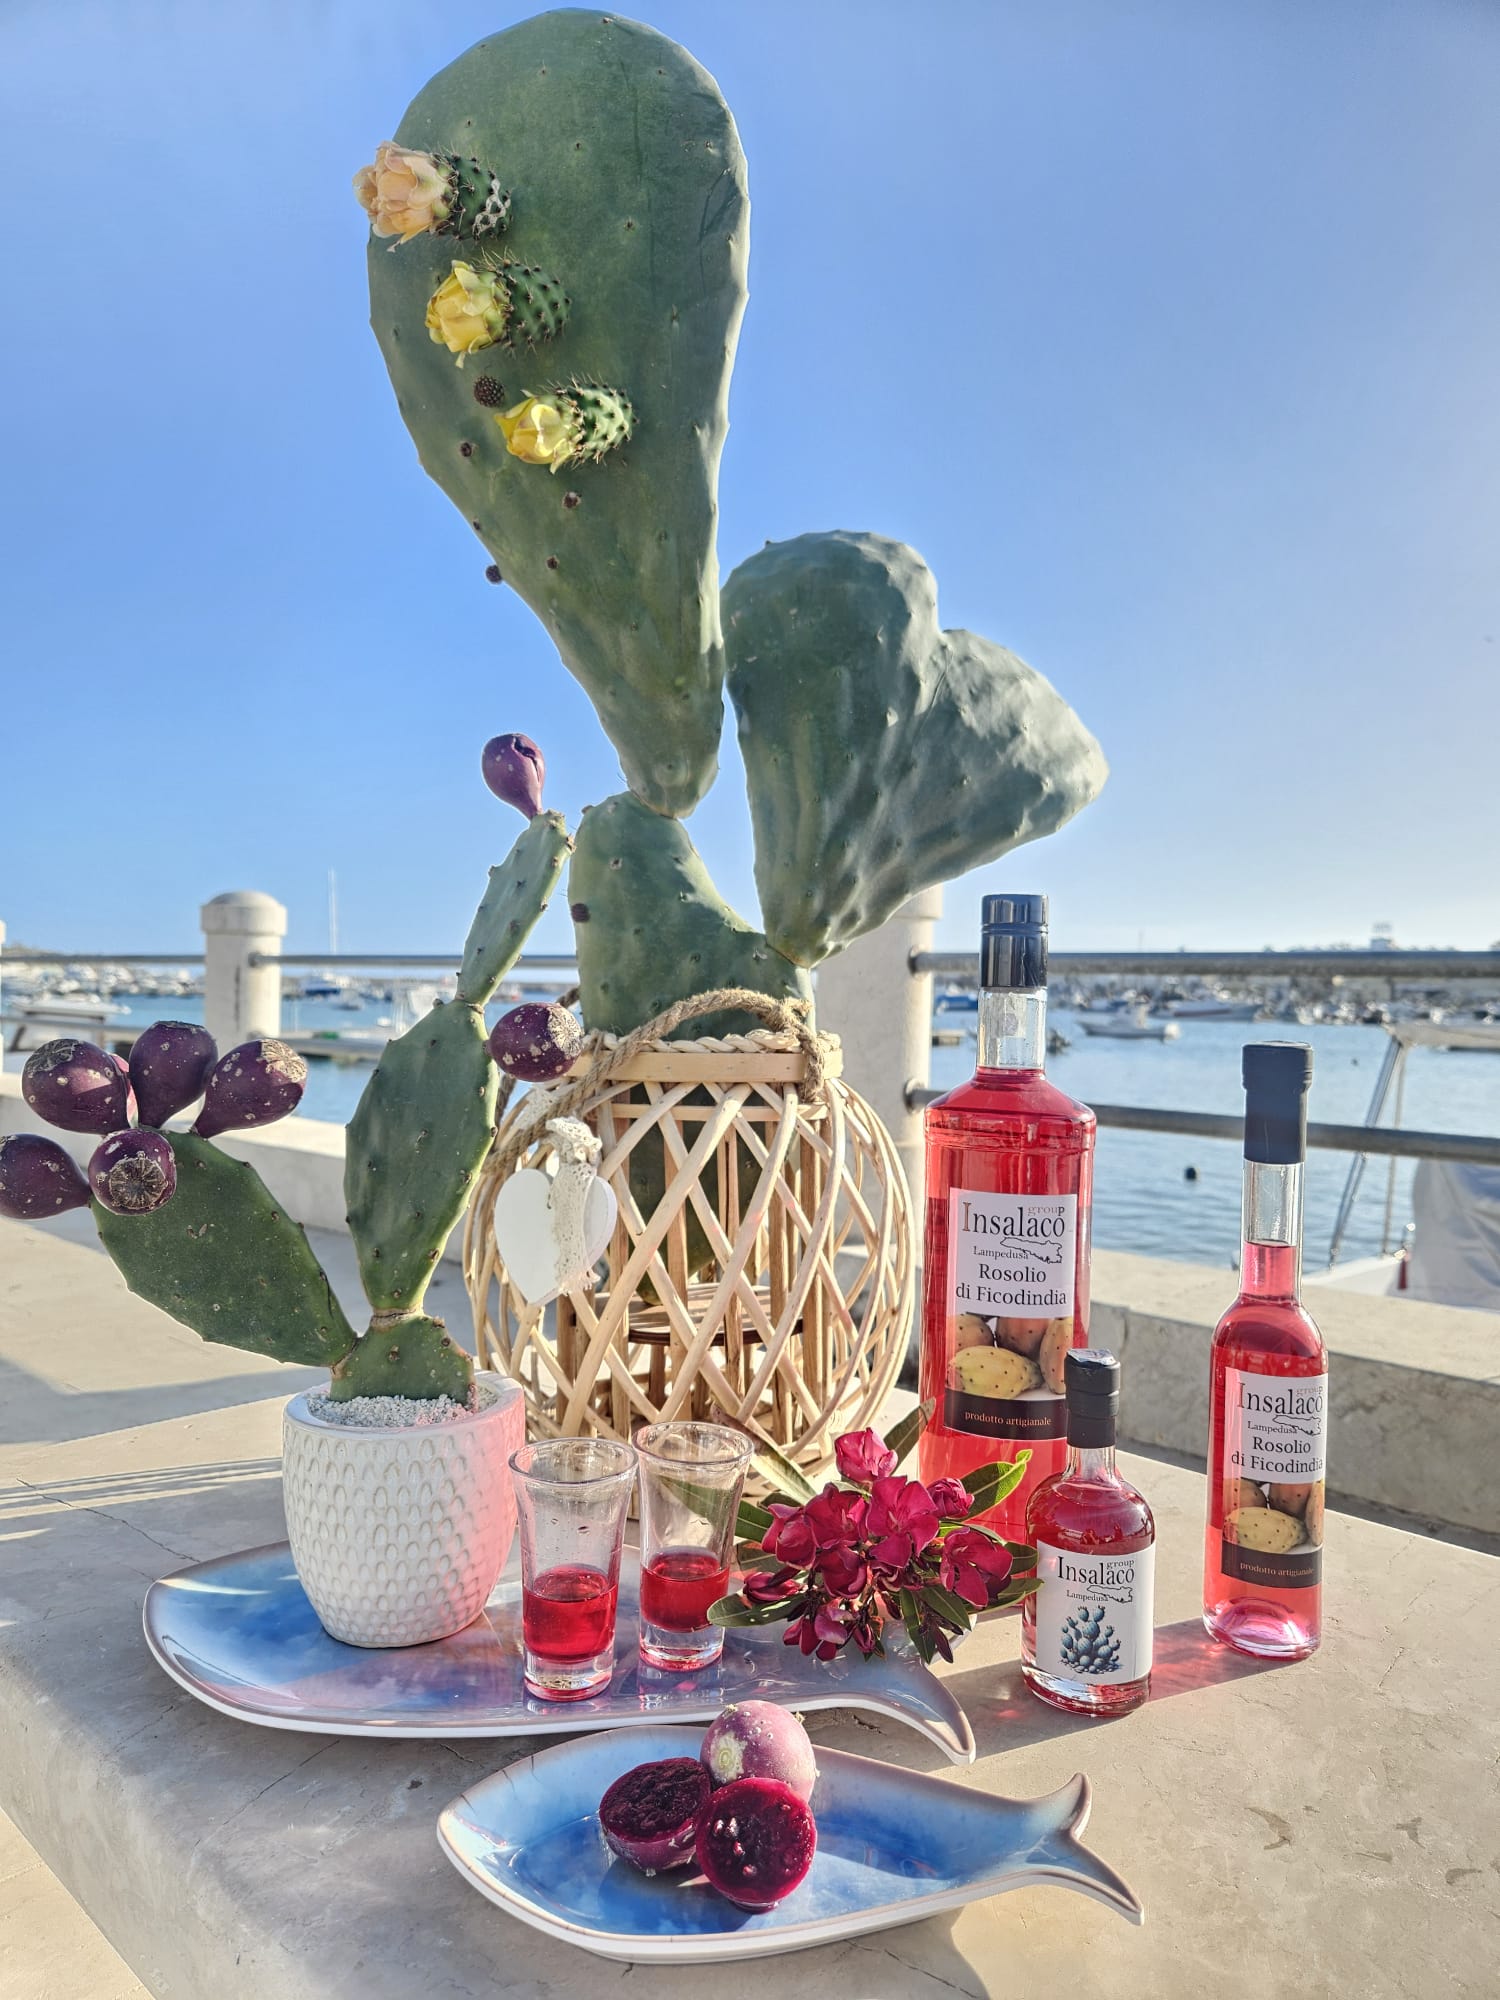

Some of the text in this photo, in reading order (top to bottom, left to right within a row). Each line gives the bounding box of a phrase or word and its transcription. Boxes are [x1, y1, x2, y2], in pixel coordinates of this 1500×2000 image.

[962, 1201, 1065, 1238] Insalaco
[1027, 1206, 1065, 1216] group
[973, 1245, 1029, 1260] Lampedusa
[979, 1263, 1047, 1283] Rosolio
[956, 1282, 1067, 1306] di Ficodindia
[1237, 1382, 1323, 1415] Insalaco
[965, 1411, 1052, 1428] prodotto artigianale
[1247, 1420, 1298, 1436] Lampedusa
[1252, 1436, 1311, 1454] Rosolio
[1231, 1450, 1323, 1474] di Ficodindia
[1057, 1555, 1135, 1586] Insalaco
[1106, 1559, 1135, 1570] group
[1240, 1561, 1276, 1576] prodotto
[1066, 1589, 1109, 1603] Lampedusa
